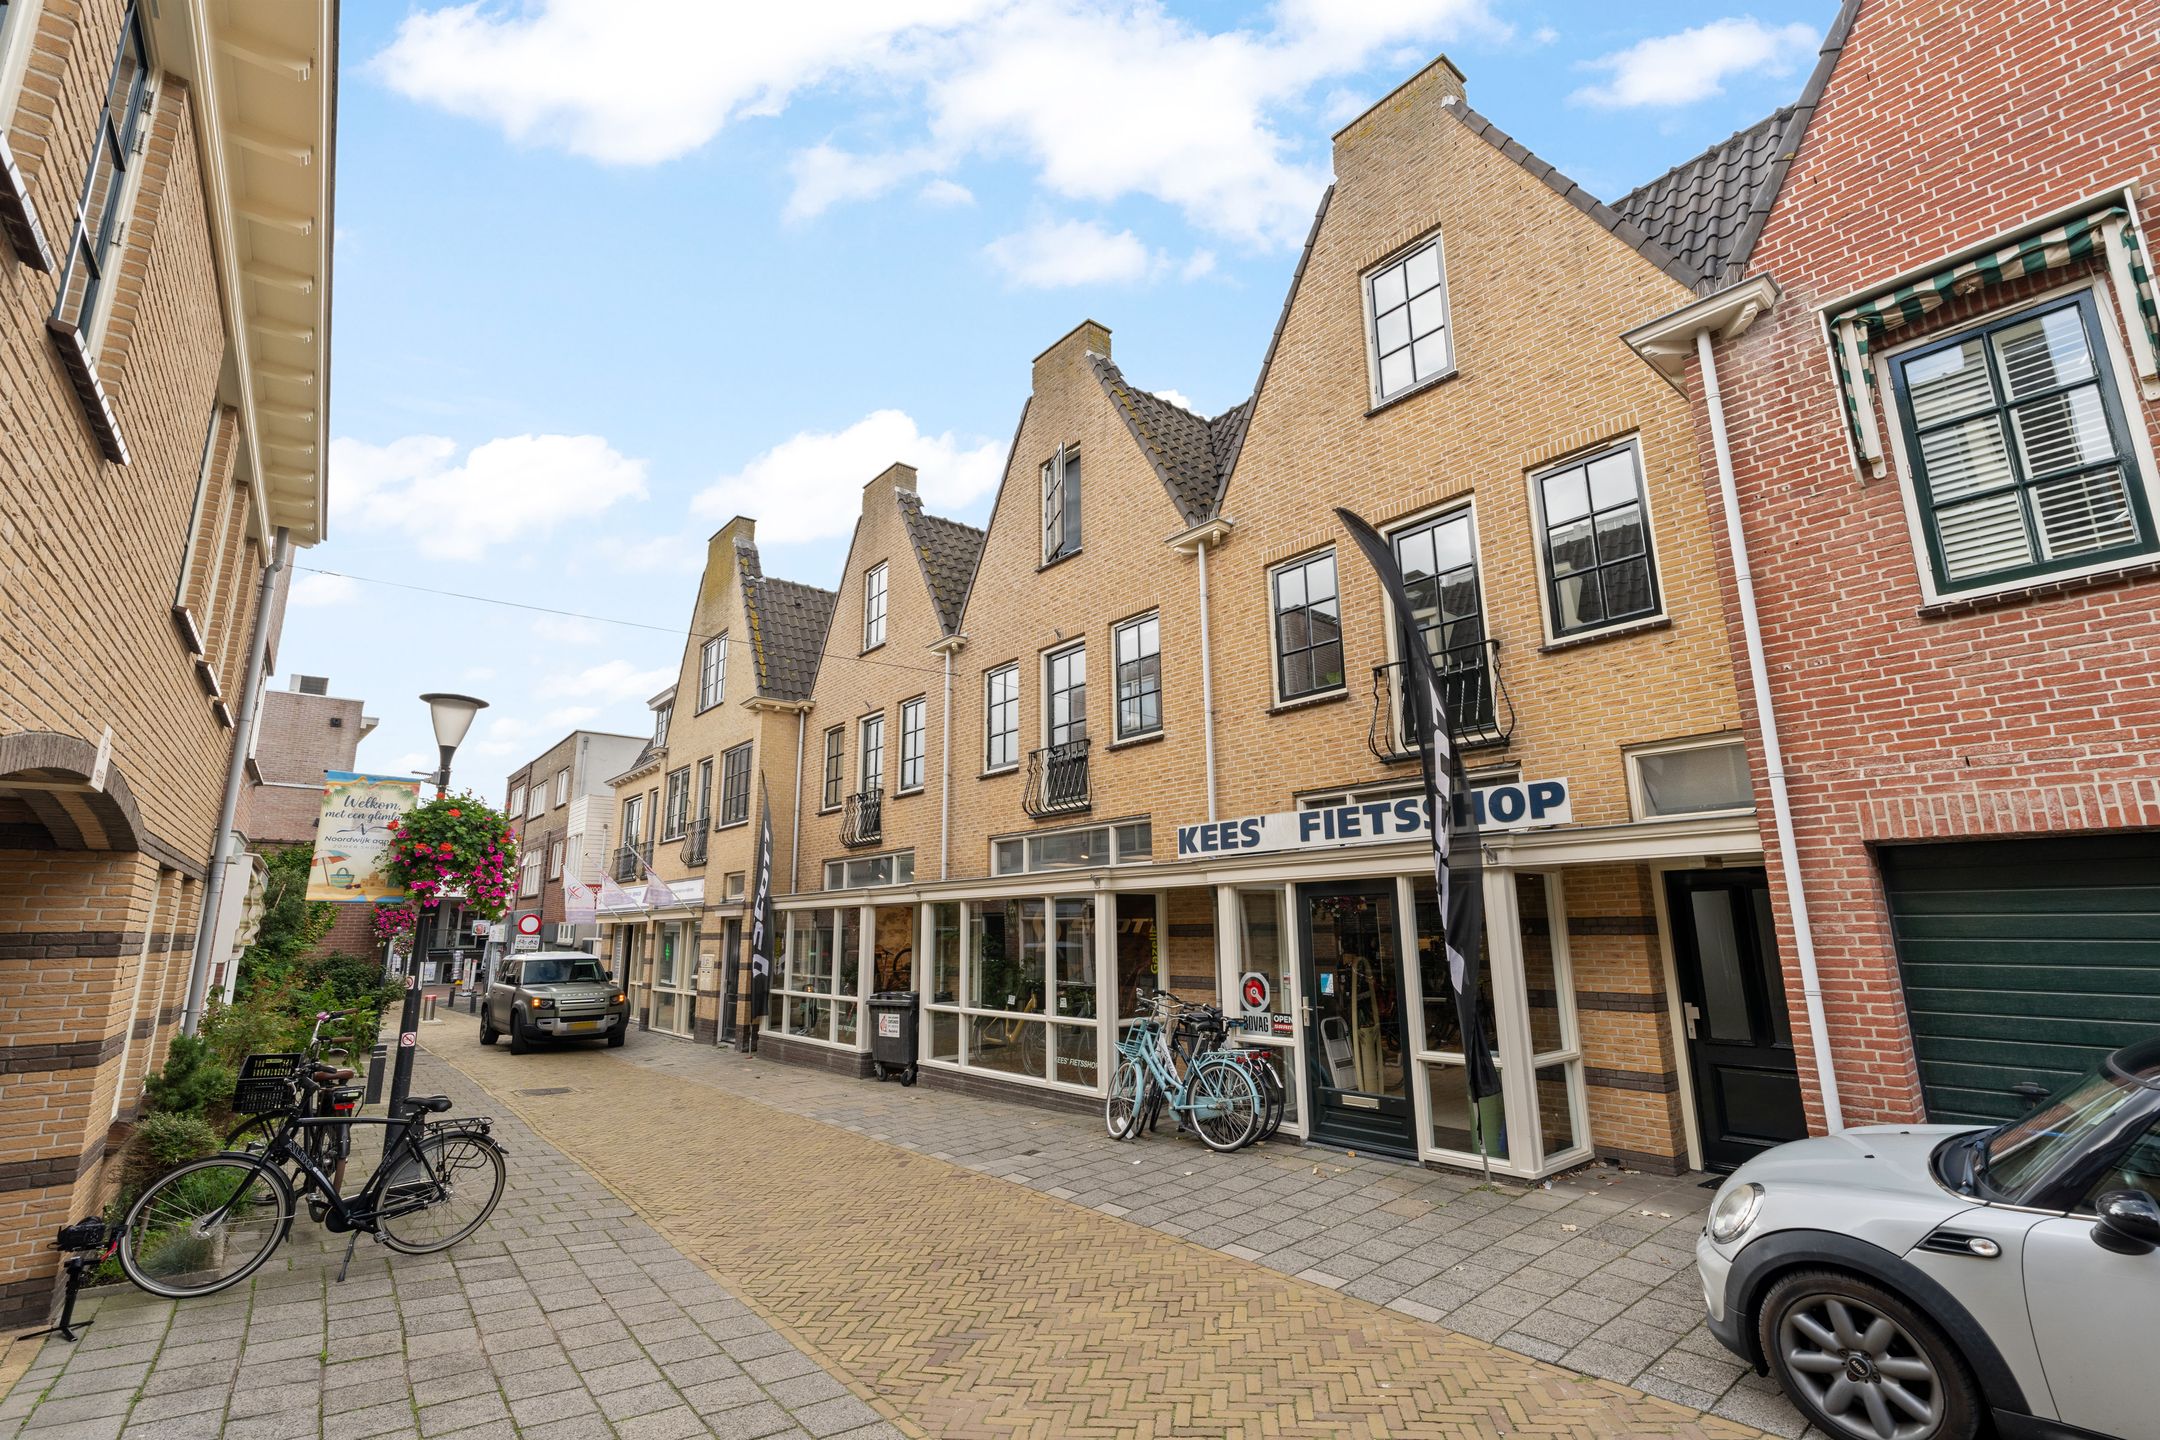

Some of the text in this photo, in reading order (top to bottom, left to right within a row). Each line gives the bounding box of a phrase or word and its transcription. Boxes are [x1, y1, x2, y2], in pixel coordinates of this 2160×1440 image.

[344, 795, 401, 811] Welkom,
[325, 810, 345, 818] met
[1178, 781, 1566, 855] KEES' FIETSHOP
[325, 836, 370, 844] Noordwijk
[753, 821, 770, 951] SCOTT
[1244, 1015, 1269, 1032] BOVAG
[1273, 1015, 1293, 1023] OPEN
[1056, 1056, 1069, 1064] EES'
[1851, 1360, 1866, 1374] MINI
